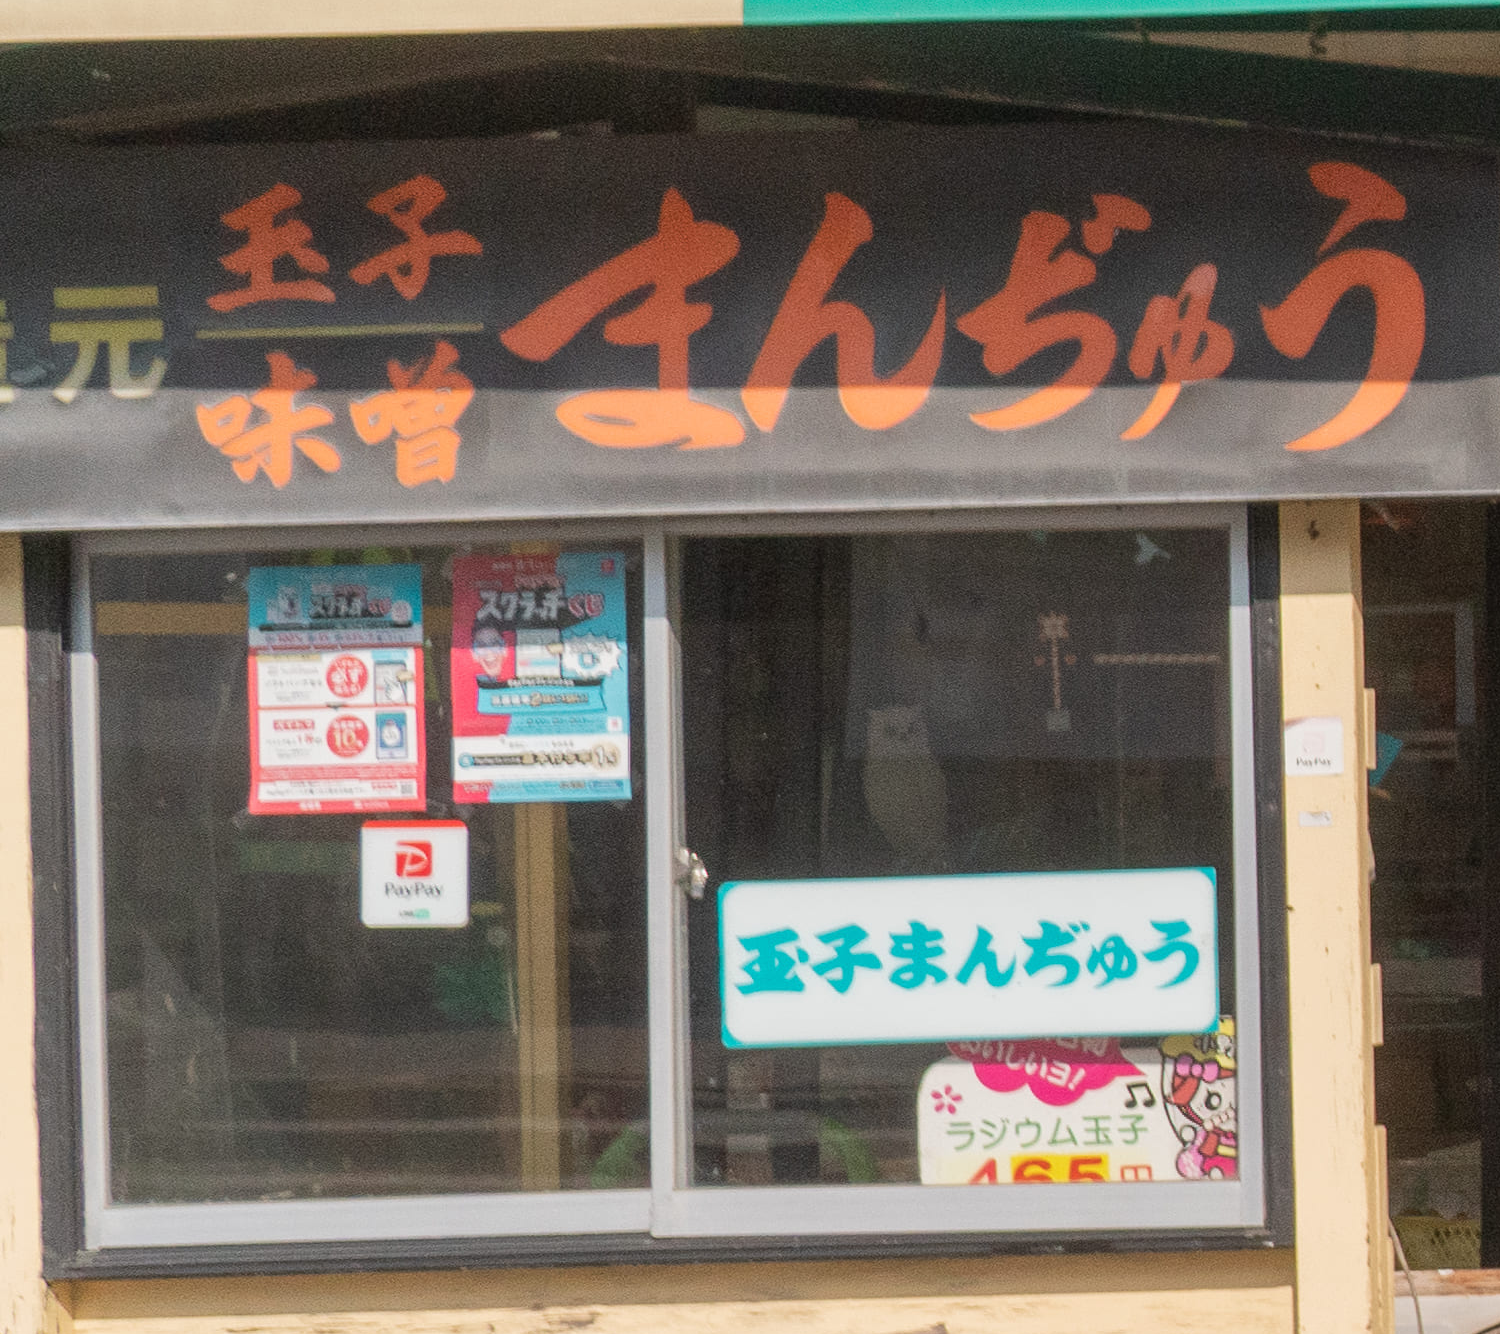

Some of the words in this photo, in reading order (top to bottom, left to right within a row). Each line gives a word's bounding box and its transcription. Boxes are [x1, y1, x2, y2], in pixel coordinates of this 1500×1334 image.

[205, 174, 484, 312] 玉子
[0, 285, 167, 405] 元
[499, 161, 1427, 451] まんぢゅう
[196, 342, 478, 490] 味噌
[476, 589, 604, 621] スクラッチくじ
[384, 881, 444, 901] PayPay
[733, 919, 1201, 995] 玉子まんぢゅう
[945, 1114, 1150, 1152] ラジウム玉子
